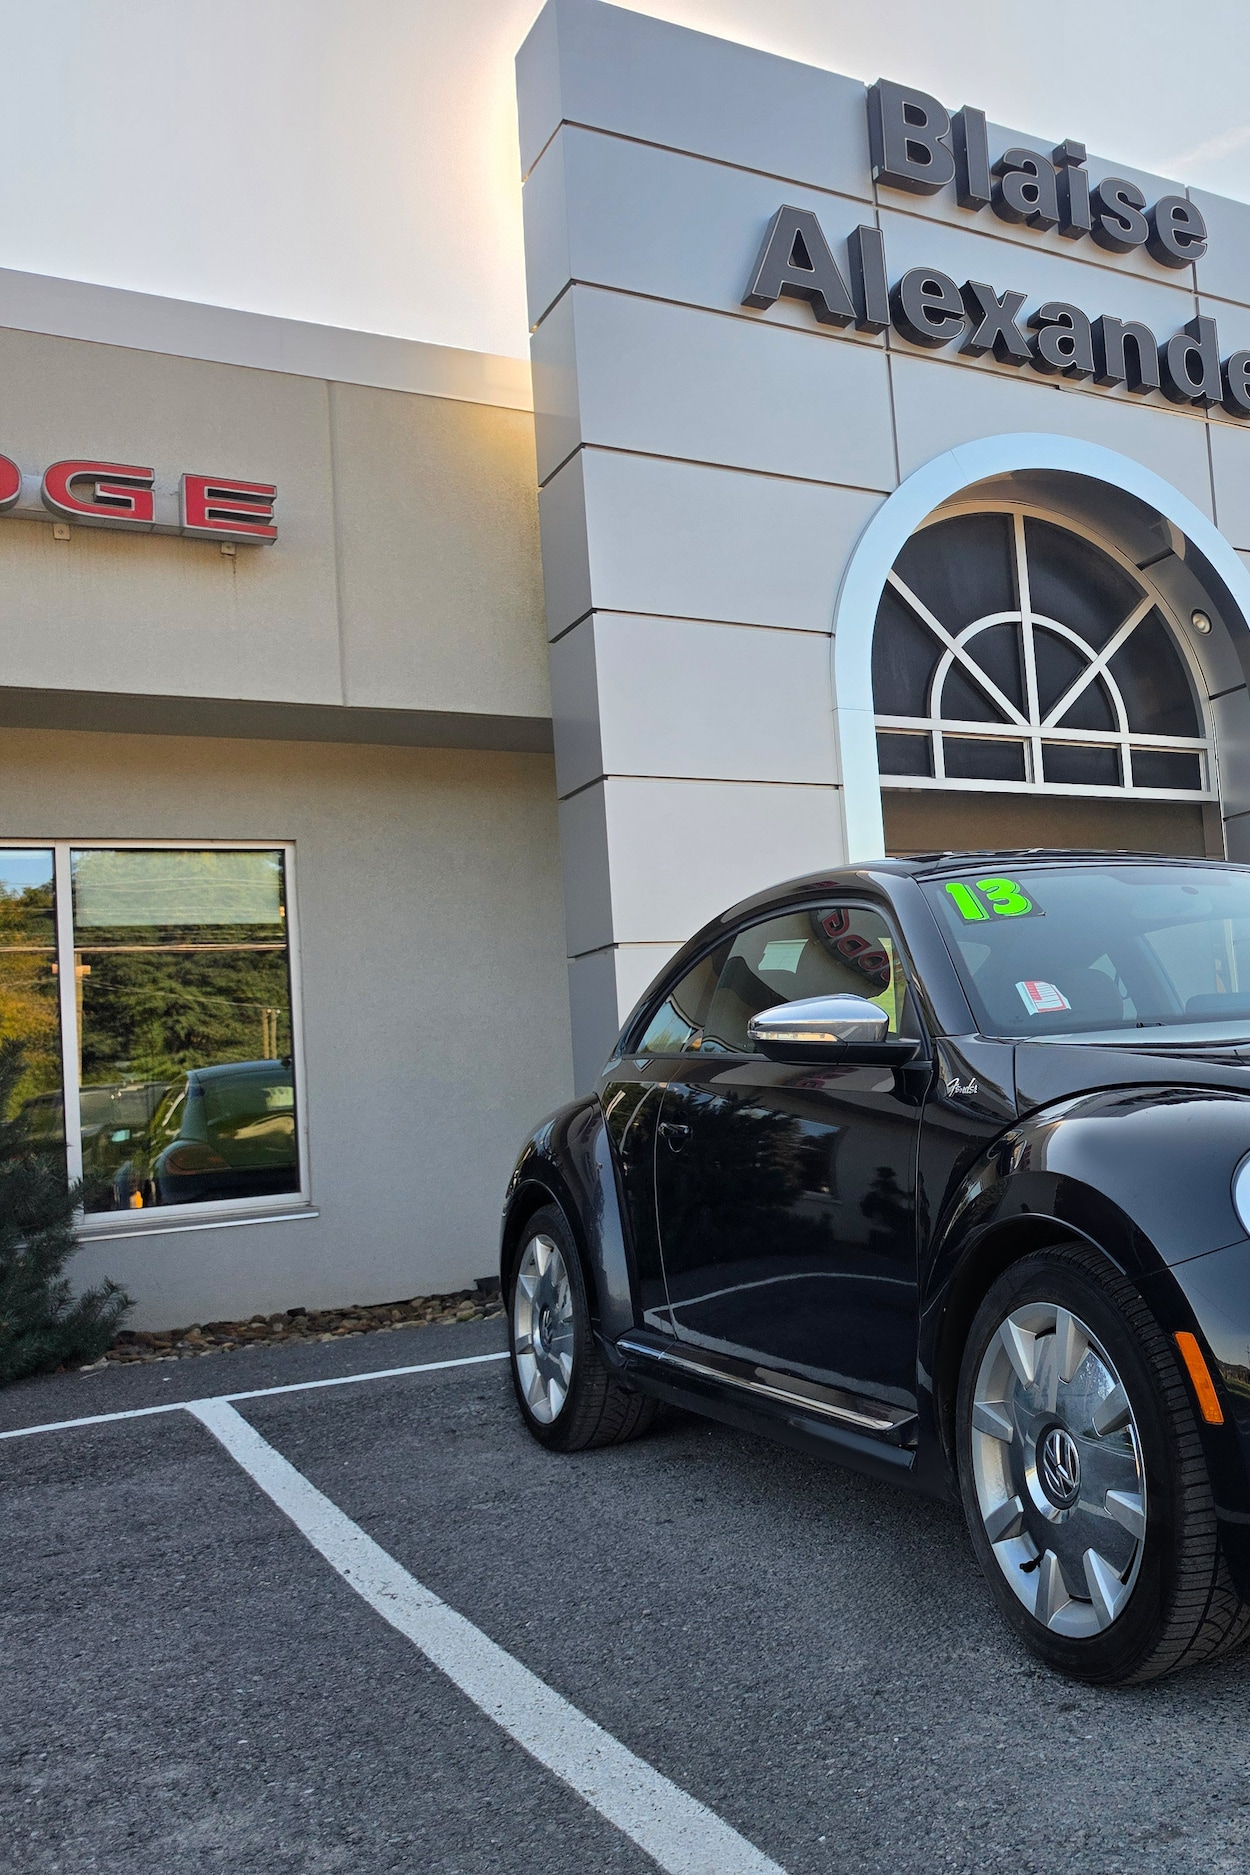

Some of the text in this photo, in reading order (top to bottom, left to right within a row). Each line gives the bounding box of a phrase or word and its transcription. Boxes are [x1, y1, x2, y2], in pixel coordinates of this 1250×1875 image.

[867, 77, 1208, 269] Blaise
[0, 454, 278, 545] GE
[945, 878, 1033, 921] 13
